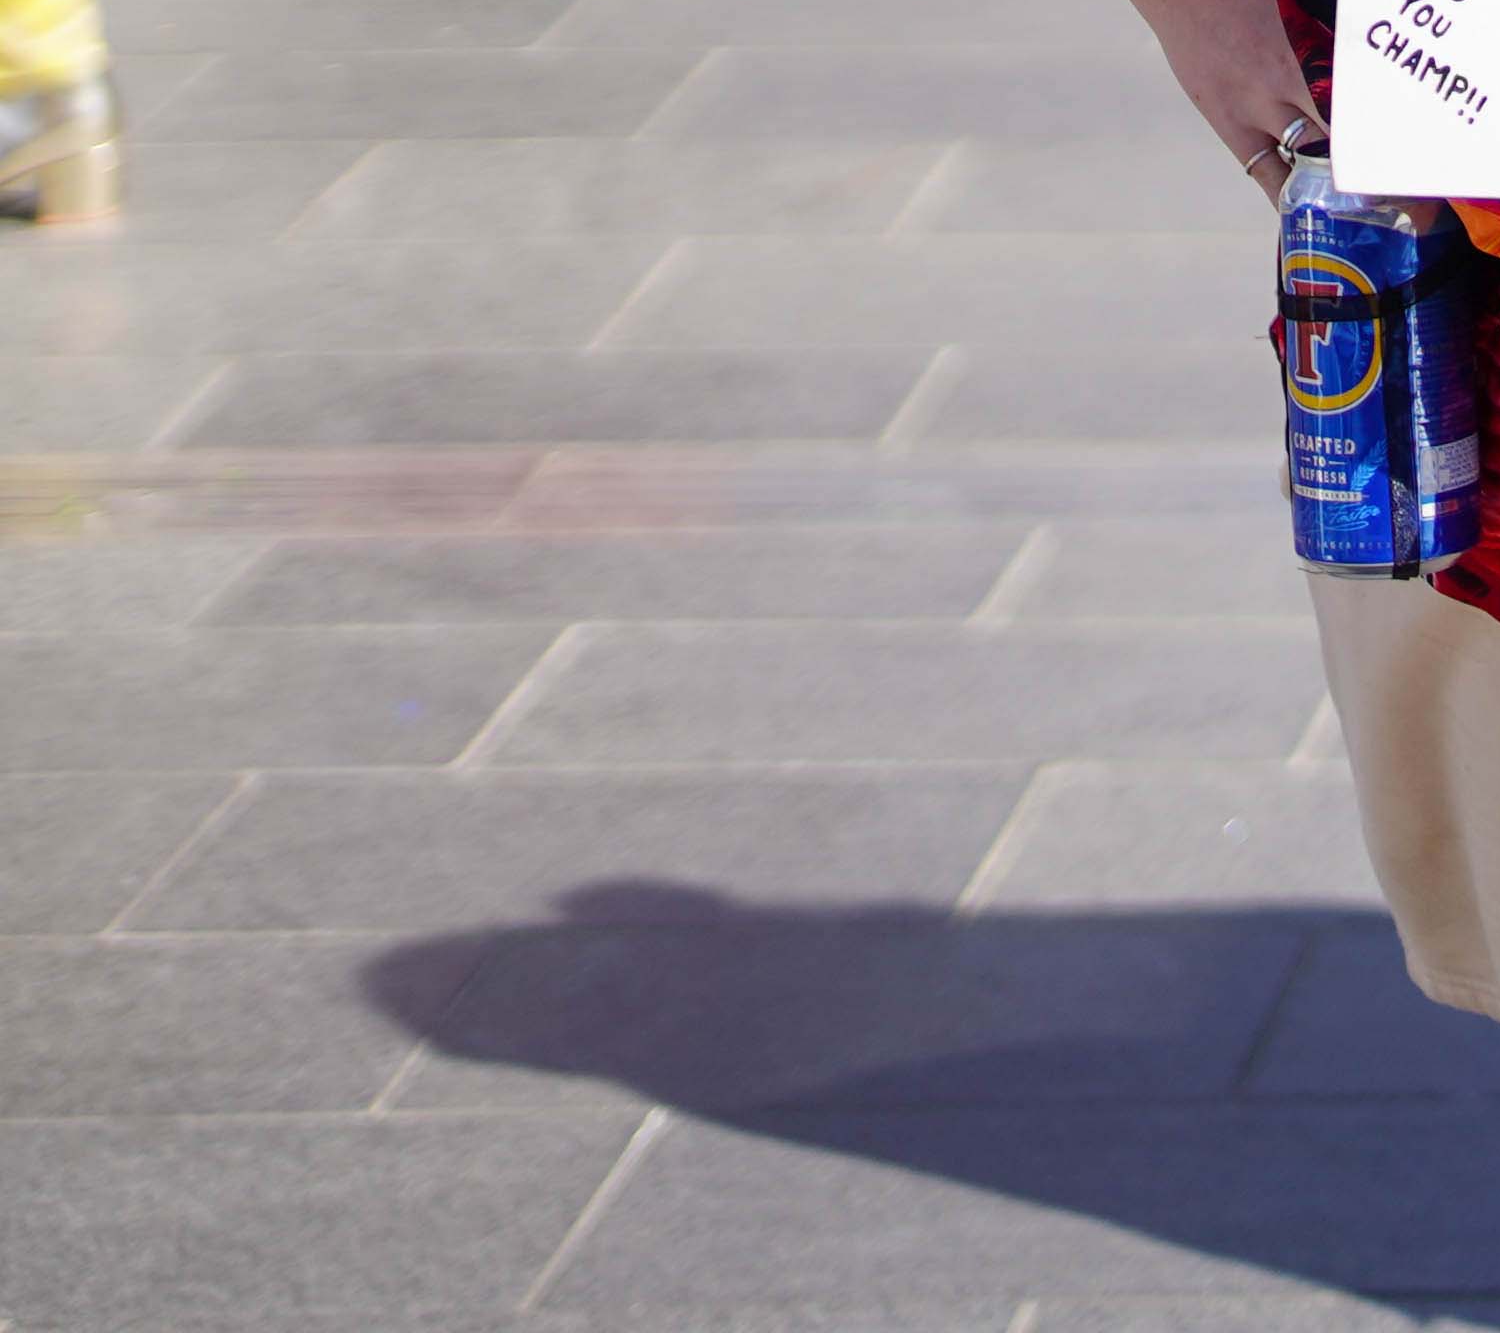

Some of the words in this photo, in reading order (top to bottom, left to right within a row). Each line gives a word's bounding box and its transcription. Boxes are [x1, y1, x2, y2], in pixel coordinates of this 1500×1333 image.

[1366, 19, 1488, 124] CHAMP!!
[1293, 432, 1356, 455] CRAFTED
[1312, 455, 1326, 468] TO
[1300, 467, 1347, 485] REFRESH
